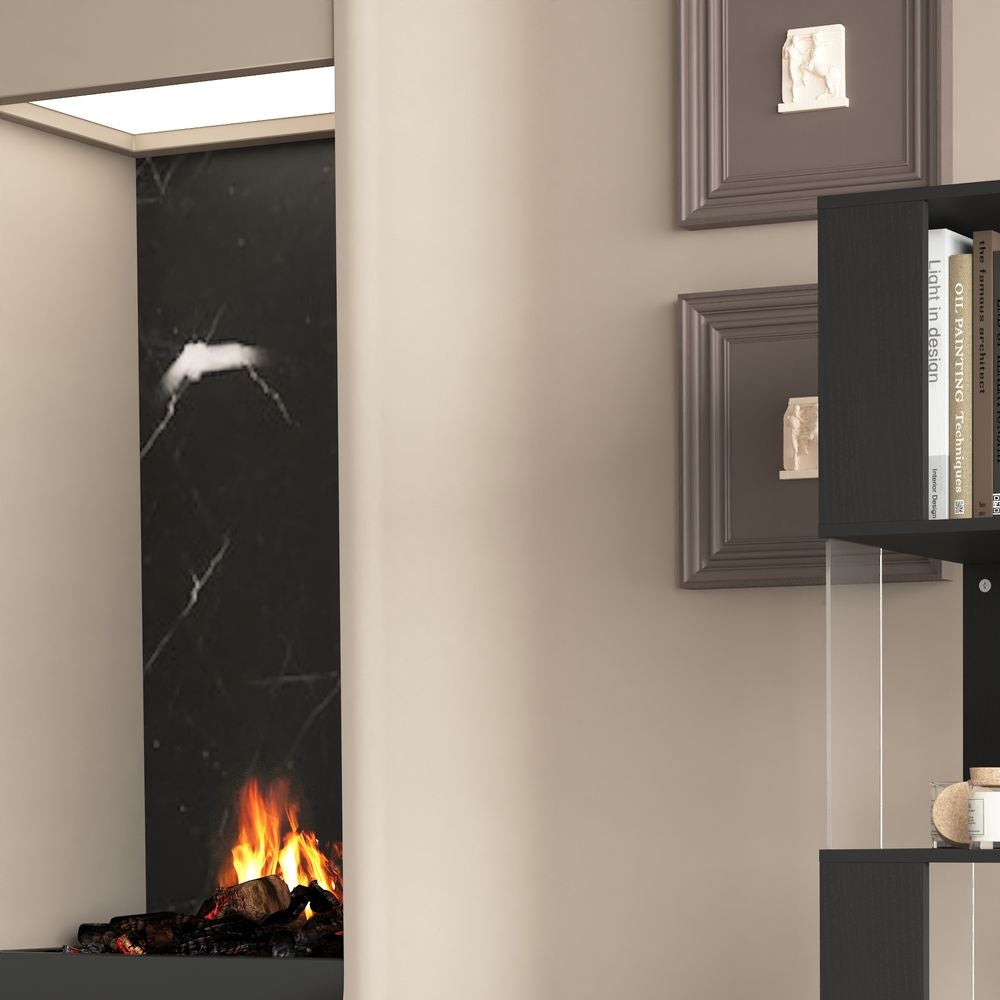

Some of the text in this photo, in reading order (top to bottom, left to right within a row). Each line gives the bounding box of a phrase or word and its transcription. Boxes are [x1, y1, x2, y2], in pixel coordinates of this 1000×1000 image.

[928, 259, 941, 383] Light in design
[953, 282, 965, 493] OIL PAINTING Techniques
[929, 495, 938, 519] Design
